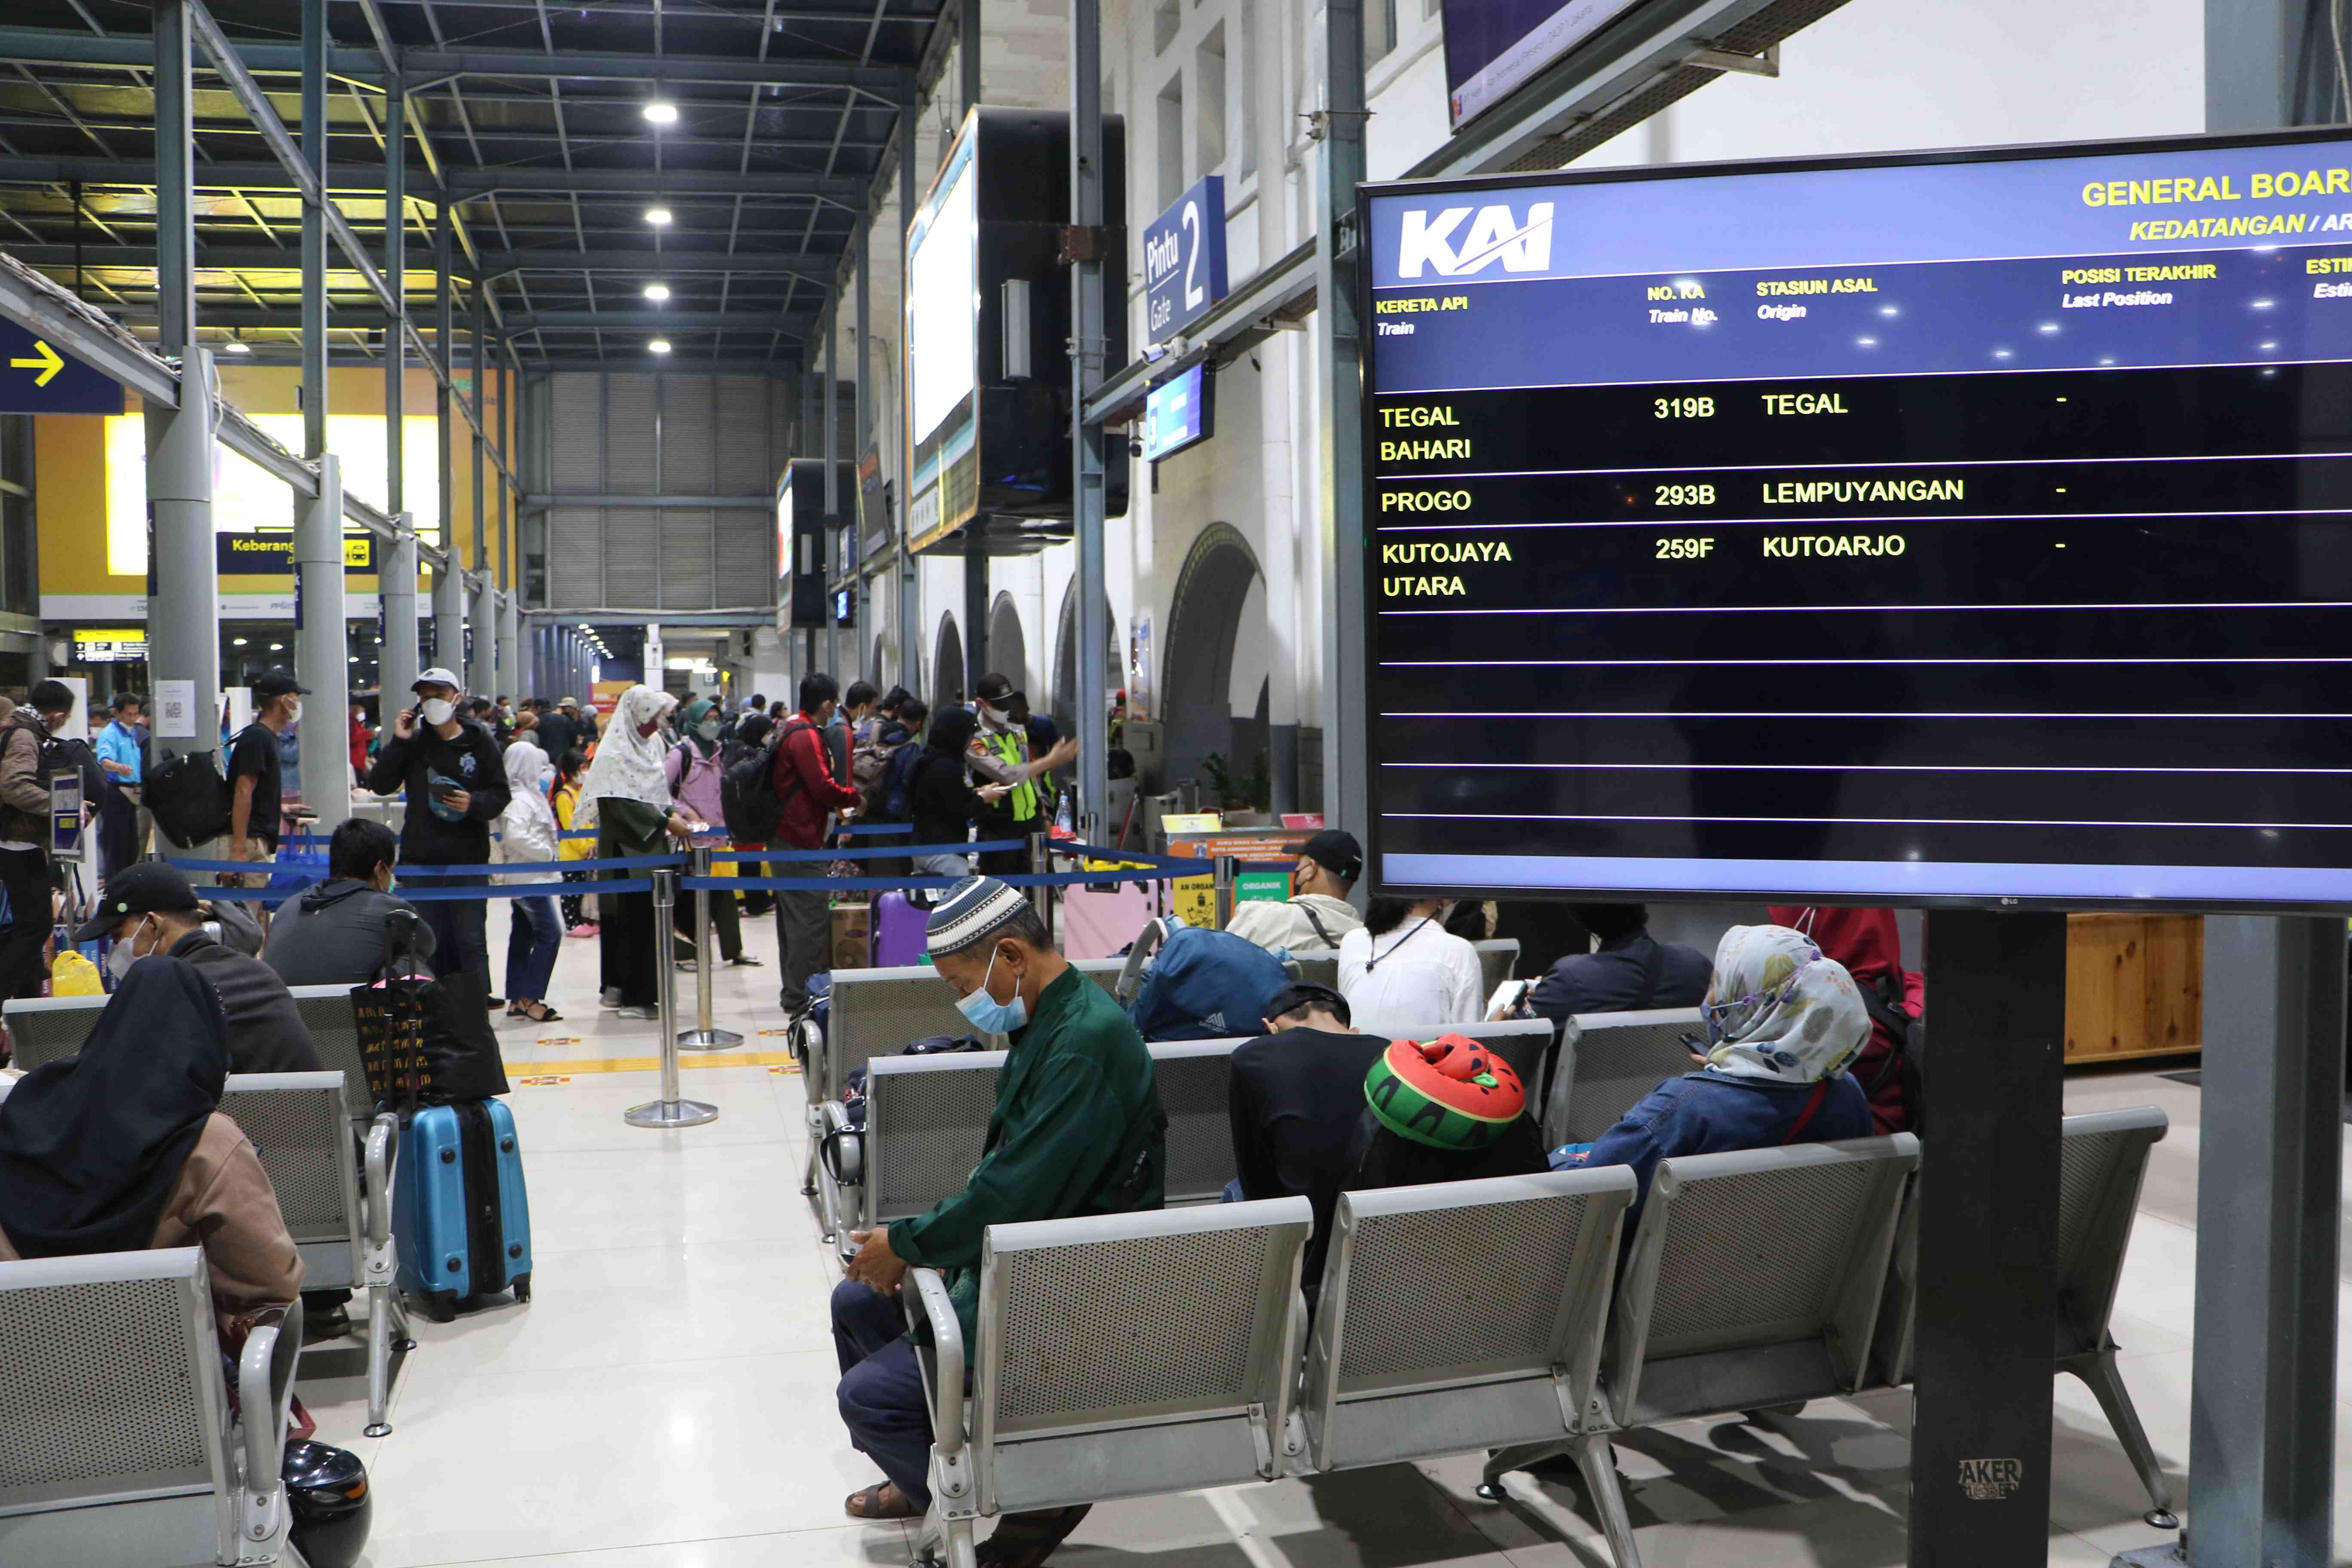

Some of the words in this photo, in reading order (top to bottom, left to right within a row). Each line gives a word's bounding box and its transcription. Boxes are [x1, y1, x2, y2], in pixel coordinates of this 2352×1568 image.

[2083, 177, 2242, 206] GENERAL
[2251, 168, 2352, 198] BOAR
[2131, 214, 2306, 241] KEDATANGAN
[2321, 213, 2352, 232] AR
[1398, 202, 1555, 278] KAI
[1147, 229, 1179, 284] Pintu
[1182, 200, 1203, 311] 2
[2062, 267, 2121, 284] POSISI
[2124, 263, 2217, 282] TERAKHIR
[1648, 286, 1677, 300] NO.
[1679, 285, 1705, 299] KA
[1757, 280, 1828, 296] STASIUN
[1831, 278, 1878, 293] ASAL
[2313, 282, 2352, 298] Esti
[1376, 297, 1438, 314] KERETA
[1440, 296, 1468, 311] API
[2062, 293, 2100, 308] Last
[2101, 290, 2172, 307] Position
[1151, 296, 1171, 331] Gate
[1648, 309, 1688, 324] Train
[1690, 308, 1718, 323] No.
[1757, 304, 1807, 322] Origin
[1377, 320, 1415, 336] Train
[1654, 396, 1715, 419] 319B
[1761, 393, 1849, 416] TEGAL
[1379, 405, 1460, 428] TEGAL
[1381, 438, 1470, 461] BAHARI
[1381, 490, 1472, 512] PROGO
[1655, 484, 1716, 506] 293B
[1763, 479, 1963, 504] LEMPUYANGAN
[233, 539, 294, 553] Keberang
[1382, 542, 1512, 564] KUTOJAYA
[1655, 538, 1715, 559] 259F
[1763, 534, 1905, 557] KUTOARJO
[1383, 576, 1466, 597] UTARA
[1959, 1461, 2021, 1484] AKER
